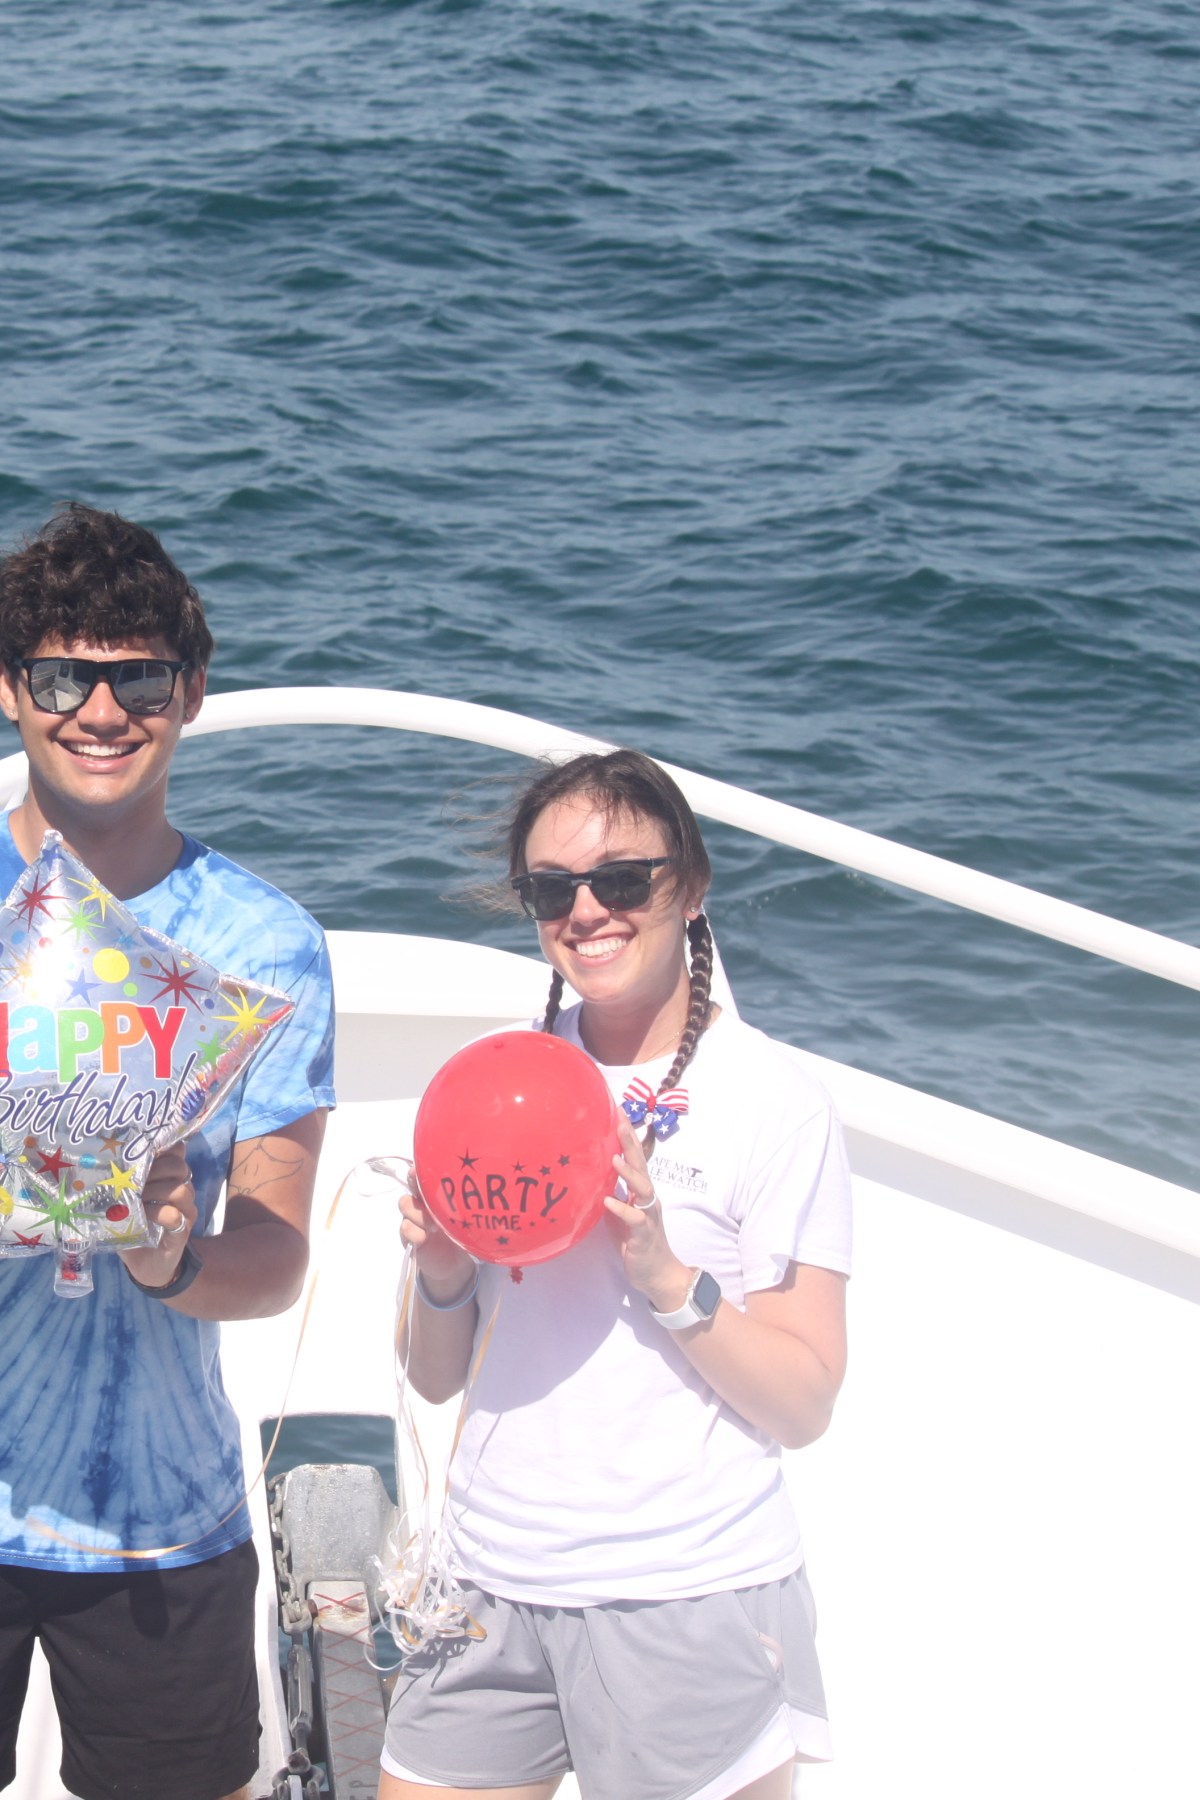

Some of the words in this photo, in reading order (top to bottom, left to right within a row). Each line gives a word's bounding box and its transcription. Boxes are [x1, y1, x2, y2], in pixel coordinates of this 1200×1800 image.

[649, 1157, 671, 1168] APE
[668, 1172, 708, 1191] WATCH
[440, 1173, 569, 1218] PARTY
[471, 1213, 521, 1232] TIME
